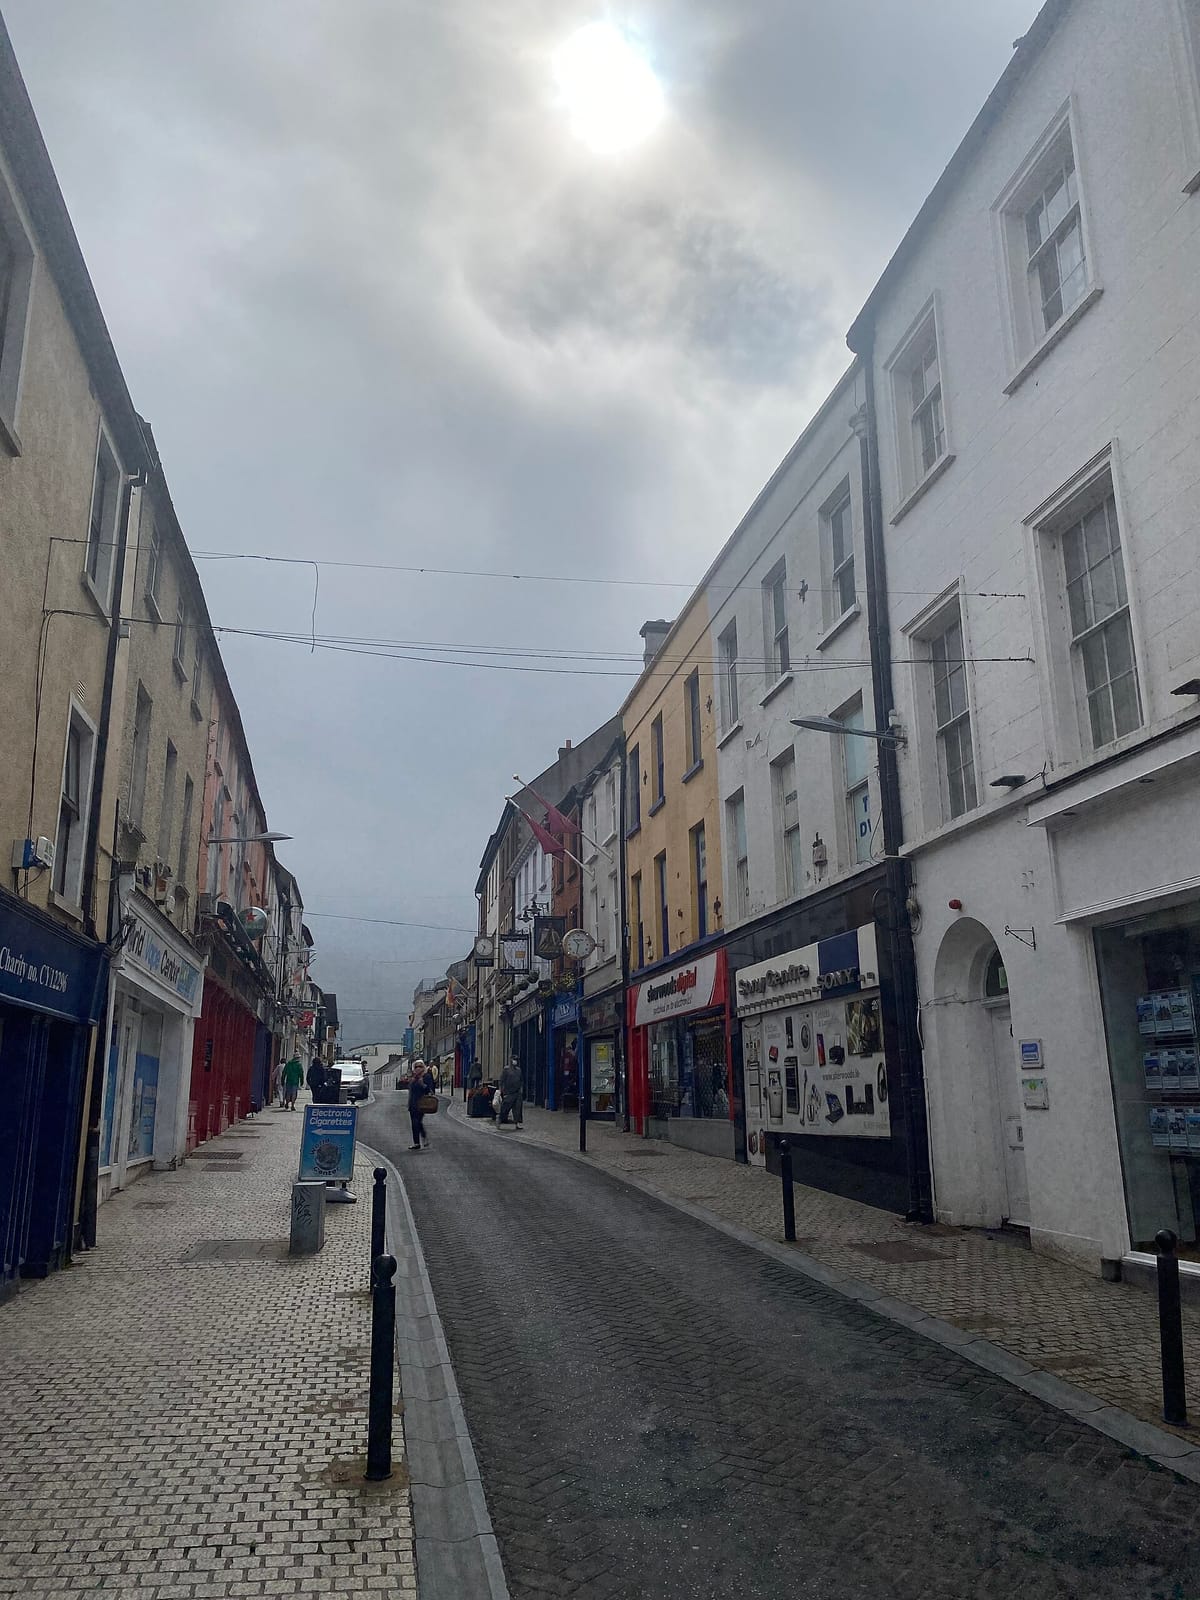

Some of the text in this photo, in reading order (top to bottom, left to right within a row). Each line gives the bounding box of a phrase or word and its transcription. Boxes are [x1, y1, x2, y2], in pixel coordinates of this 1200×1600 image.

[0, 946, 28, 984] Charity
[27, 964, 38, 983] no.
[765, 963, 810, 988] Centre
[816, 966, 857, 992] SONY
[309, 1117, 353, 1127] Cigarettes
[311, 1108, 352, 1117] Electronic
